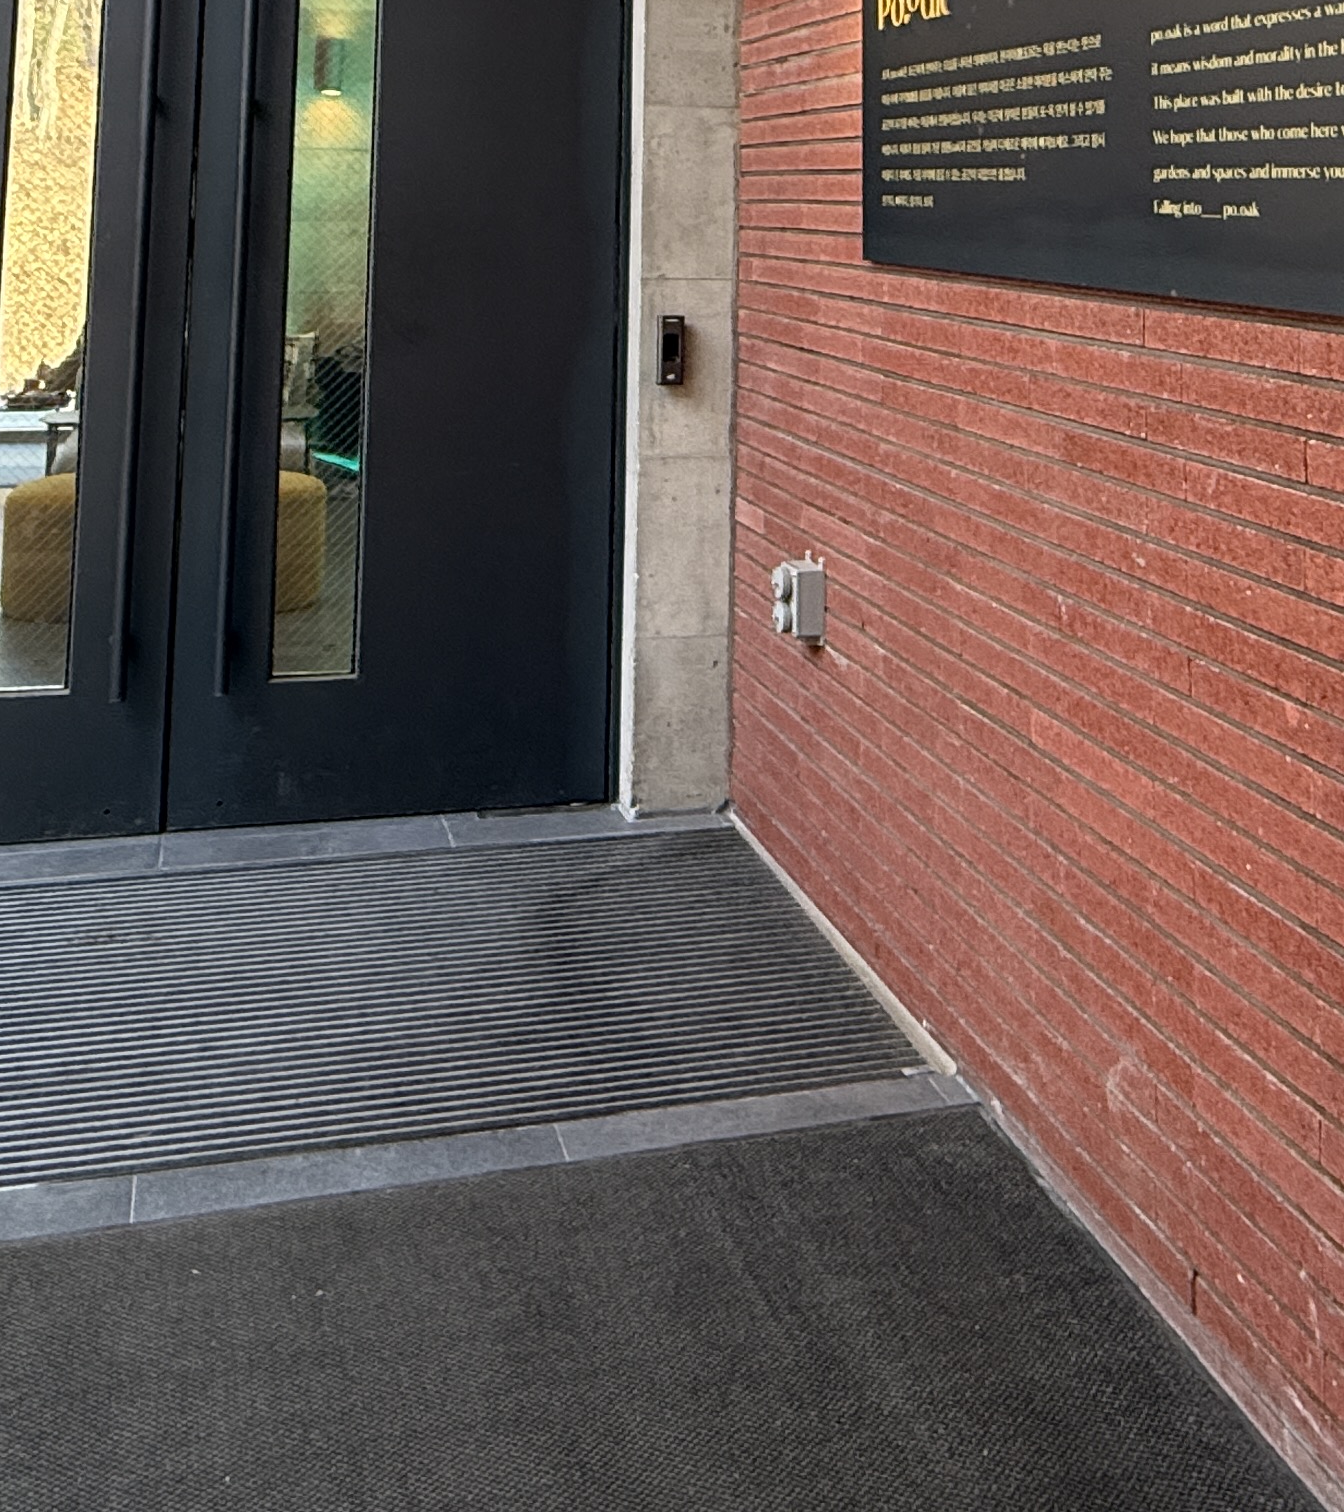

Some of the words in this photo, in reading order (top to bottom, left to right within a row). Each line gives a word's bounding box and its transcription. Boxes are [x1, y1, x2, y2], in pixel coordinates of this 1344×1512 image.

[1183, 23, 1193, 37] is
[1194, 24, 1200, 36] a
[1203, 16, 1229, 34] word
[1231, 13, 1252, 30] that
[1254, 6, 1311, 29] expresses
[1313, 6, 1322, 18] a
[1160, 61, 1191, 75] means
[1193, 54, 1232, 70] wisdom
[1234, 49, 1254, 66] and
[1256, 45, 1303, 63] morality
[1304, 43, 1316, 59] in
[1318, 40, 1338, 57] the
[1154, 95, 1172, 110] This
[1174, 93, 1198, 112] place
[1200, 94, 1221, 107] was
[1222, 89, 1245, 105] built
[1247, 86, 1273, 103] with
[1275, 84, 1294, 101] the
[1295, 82, 1333, 100] desire
[1153, 129, 1169, 145] We
[1170, 129, 1194, 147] hope
[1195, 128, 1217, 143] that
[1218, 127, 1249, 142] those
[1250, 124, 1275, 140] who
[1277, 127, 1309, 140] come
[1311, 122, 1338, 139] here
[1153, 164, 1191, 183] gardens
[1191, 164, 1211, 179] and
[1212, 166, 1247, 182] spaces
[1249, 163, 1270, 179] and
[1271, 163, 1321, 179] immerse
[1153, 199, 1182, 218] Falling
